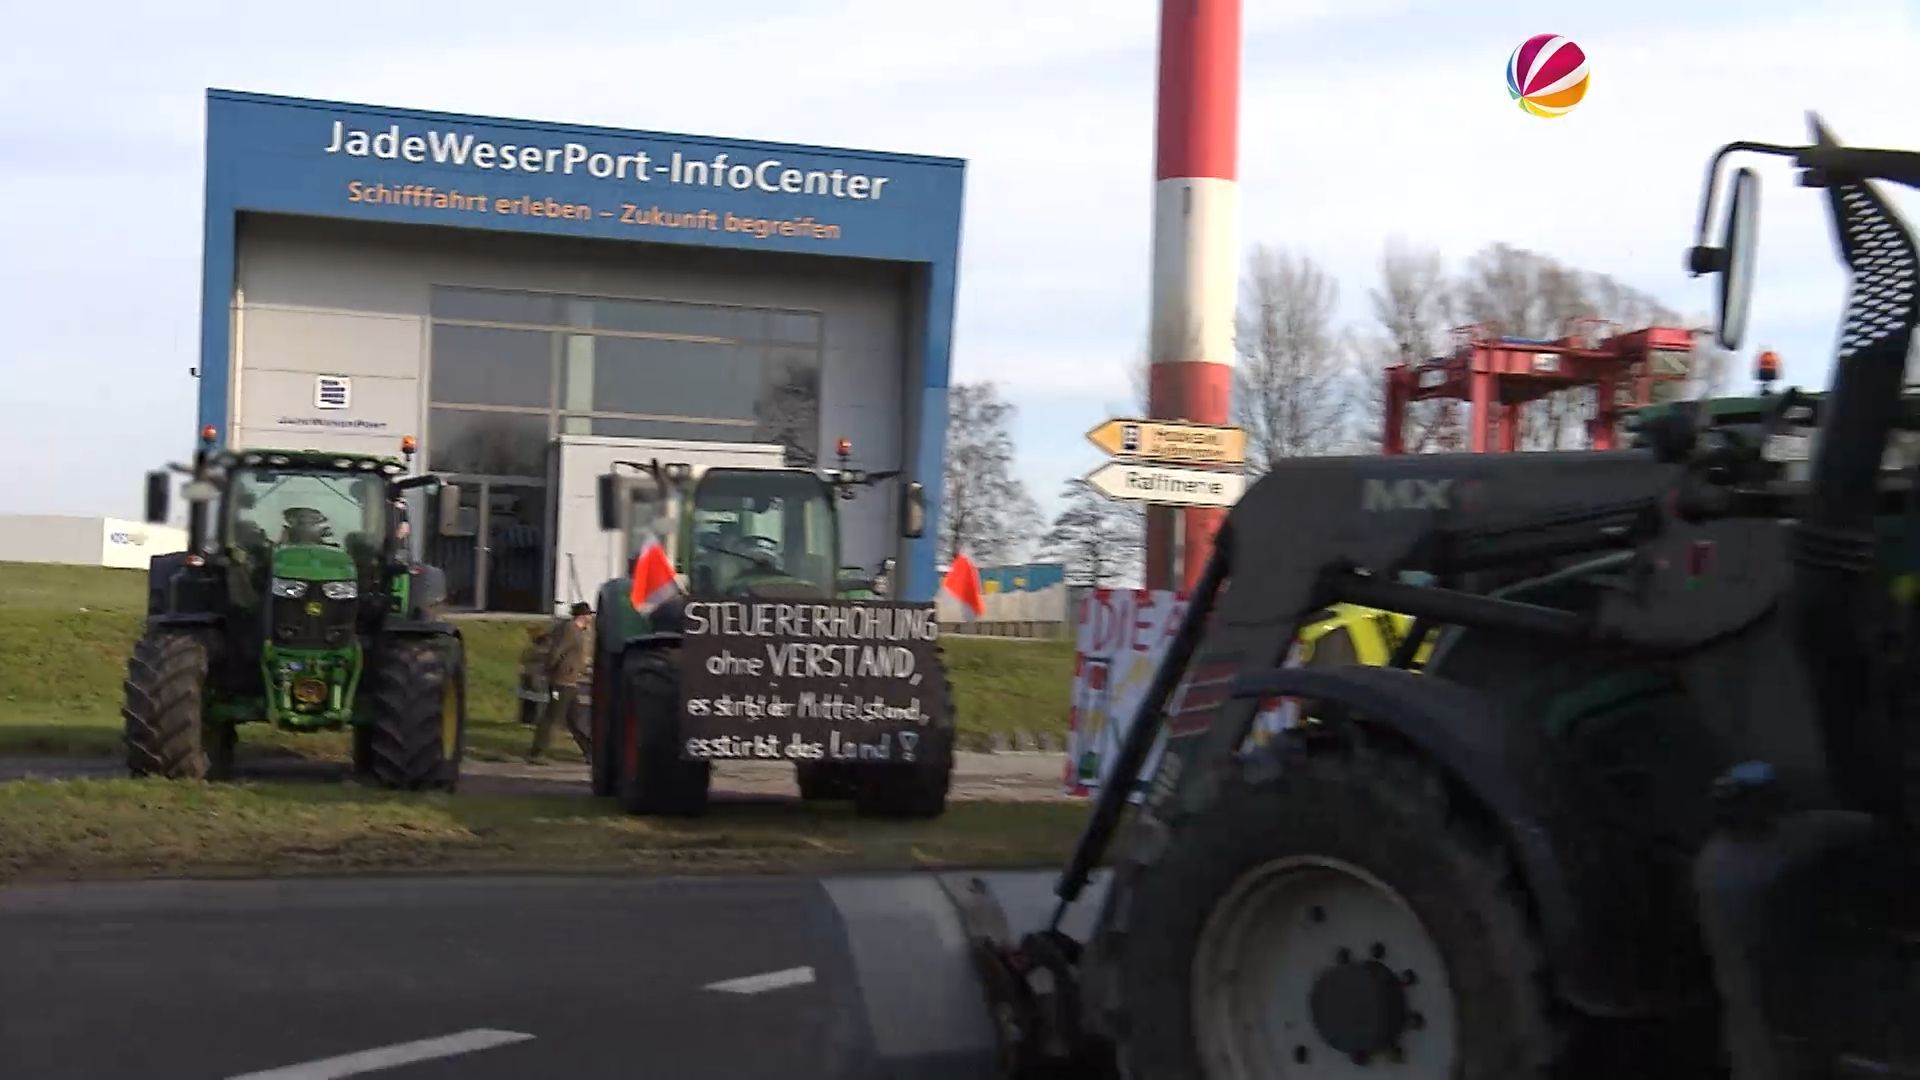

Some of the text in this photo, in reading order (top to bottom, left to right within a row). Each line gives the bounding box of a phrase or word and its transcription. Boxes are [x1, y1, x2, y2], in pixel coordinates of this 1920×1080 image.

[324, 120, 889, 200] JadeWeserPort-InfoCenter
[348, 180, 488, 213] Schifffahrt
[495, 195, 592, 221] erleben
[620, 203, 718, 231] Zukunft
[724, 211, 842, 240] begreifen
[684, 601, 938, 641] STEUERERHÖHUNG
[706, 649, 764, 676] ohne
